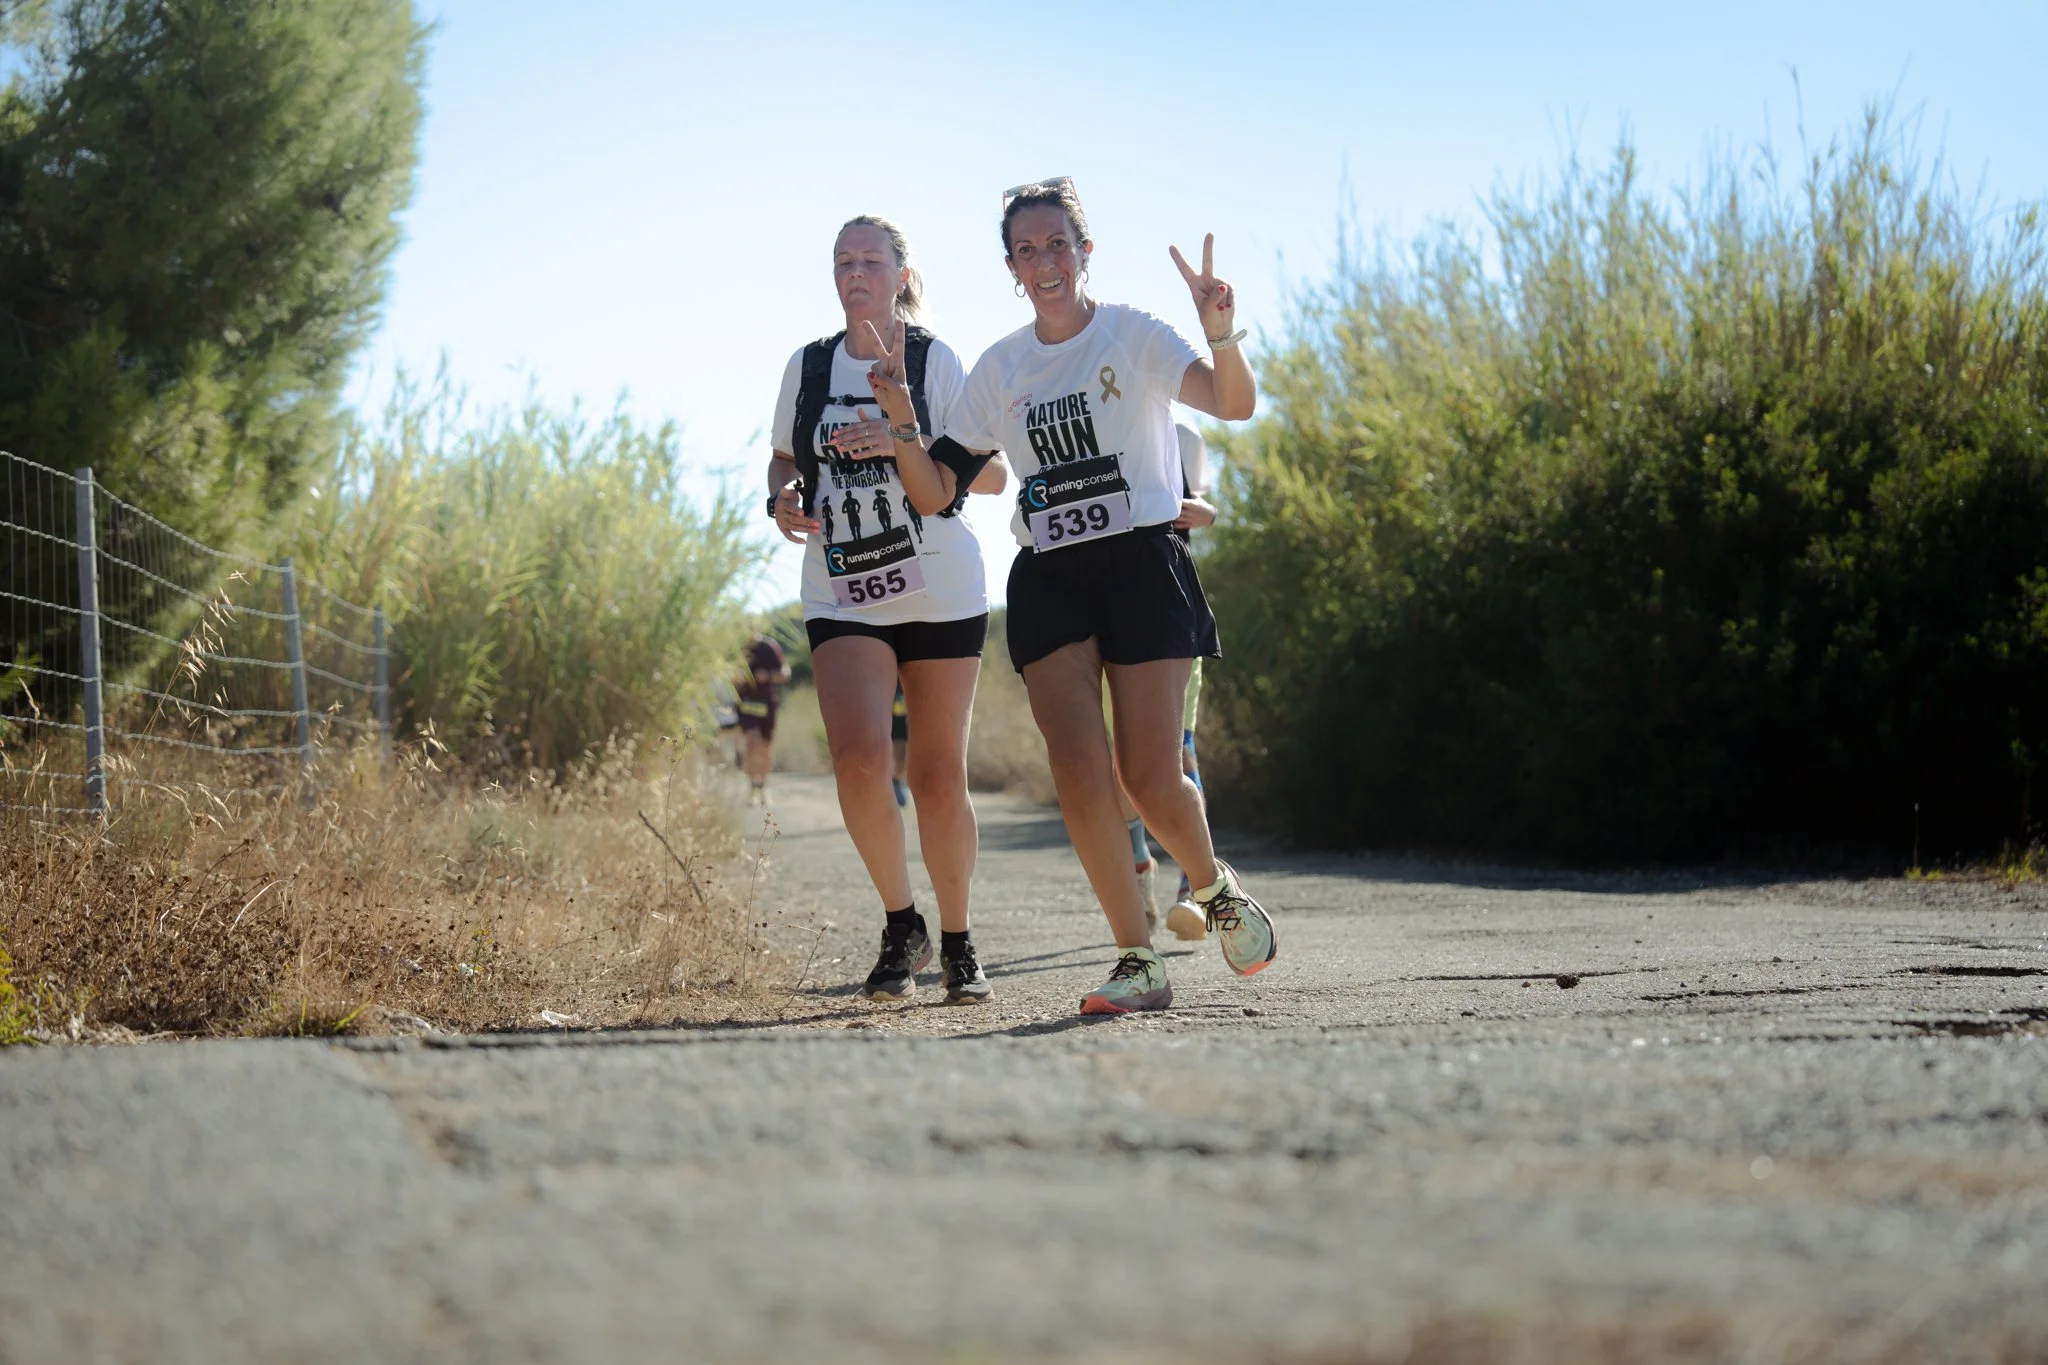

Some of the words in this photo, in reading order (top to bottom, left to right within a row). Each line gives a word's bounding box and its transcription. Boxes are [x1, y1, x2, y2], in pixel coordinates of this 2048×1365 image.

[1026, 392, 1091, 428] NATURE
[1027, 416, 1100, 467] RUN
[1049, 469, 1119, 495] runningconseil
[1048, 503, 1110, 542] 539
[847, 537, 911, 564] runningconseil
[847, 568, 907, 604] 565
